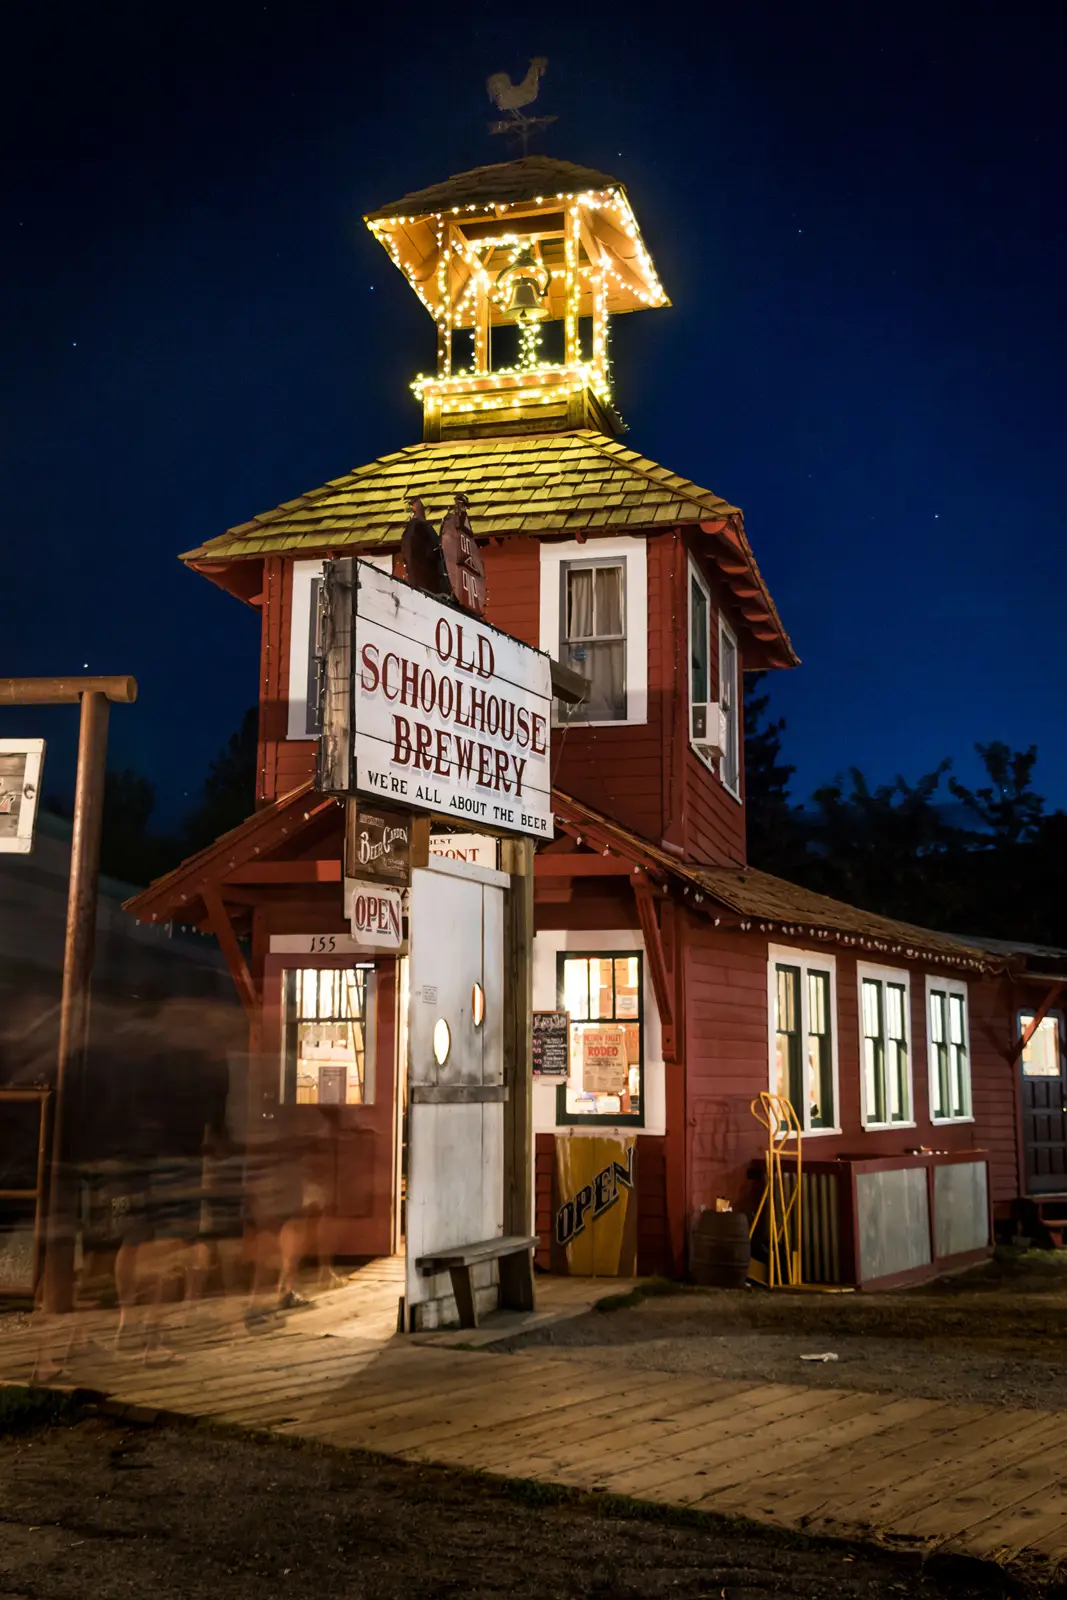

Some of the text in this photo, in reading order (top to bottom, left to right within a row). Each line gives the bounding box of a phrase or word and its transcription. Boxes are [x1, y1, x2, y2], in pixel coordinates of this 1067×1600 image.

[435, 617, 495, 680] OLD
[361, 643, 547, 756] SCHOOLHOUSE
[391, 714, 527, 798] BREWERY
[367, 769, 547, 831] WE'RE ALL ABOUT THE BEER
[309, 936, 336, 953] 155
[355, 895, 400, 944] OPEN
[587, 1046, 619, 1057] RODEO
[556, 1146, 635, 1245] OPEN
